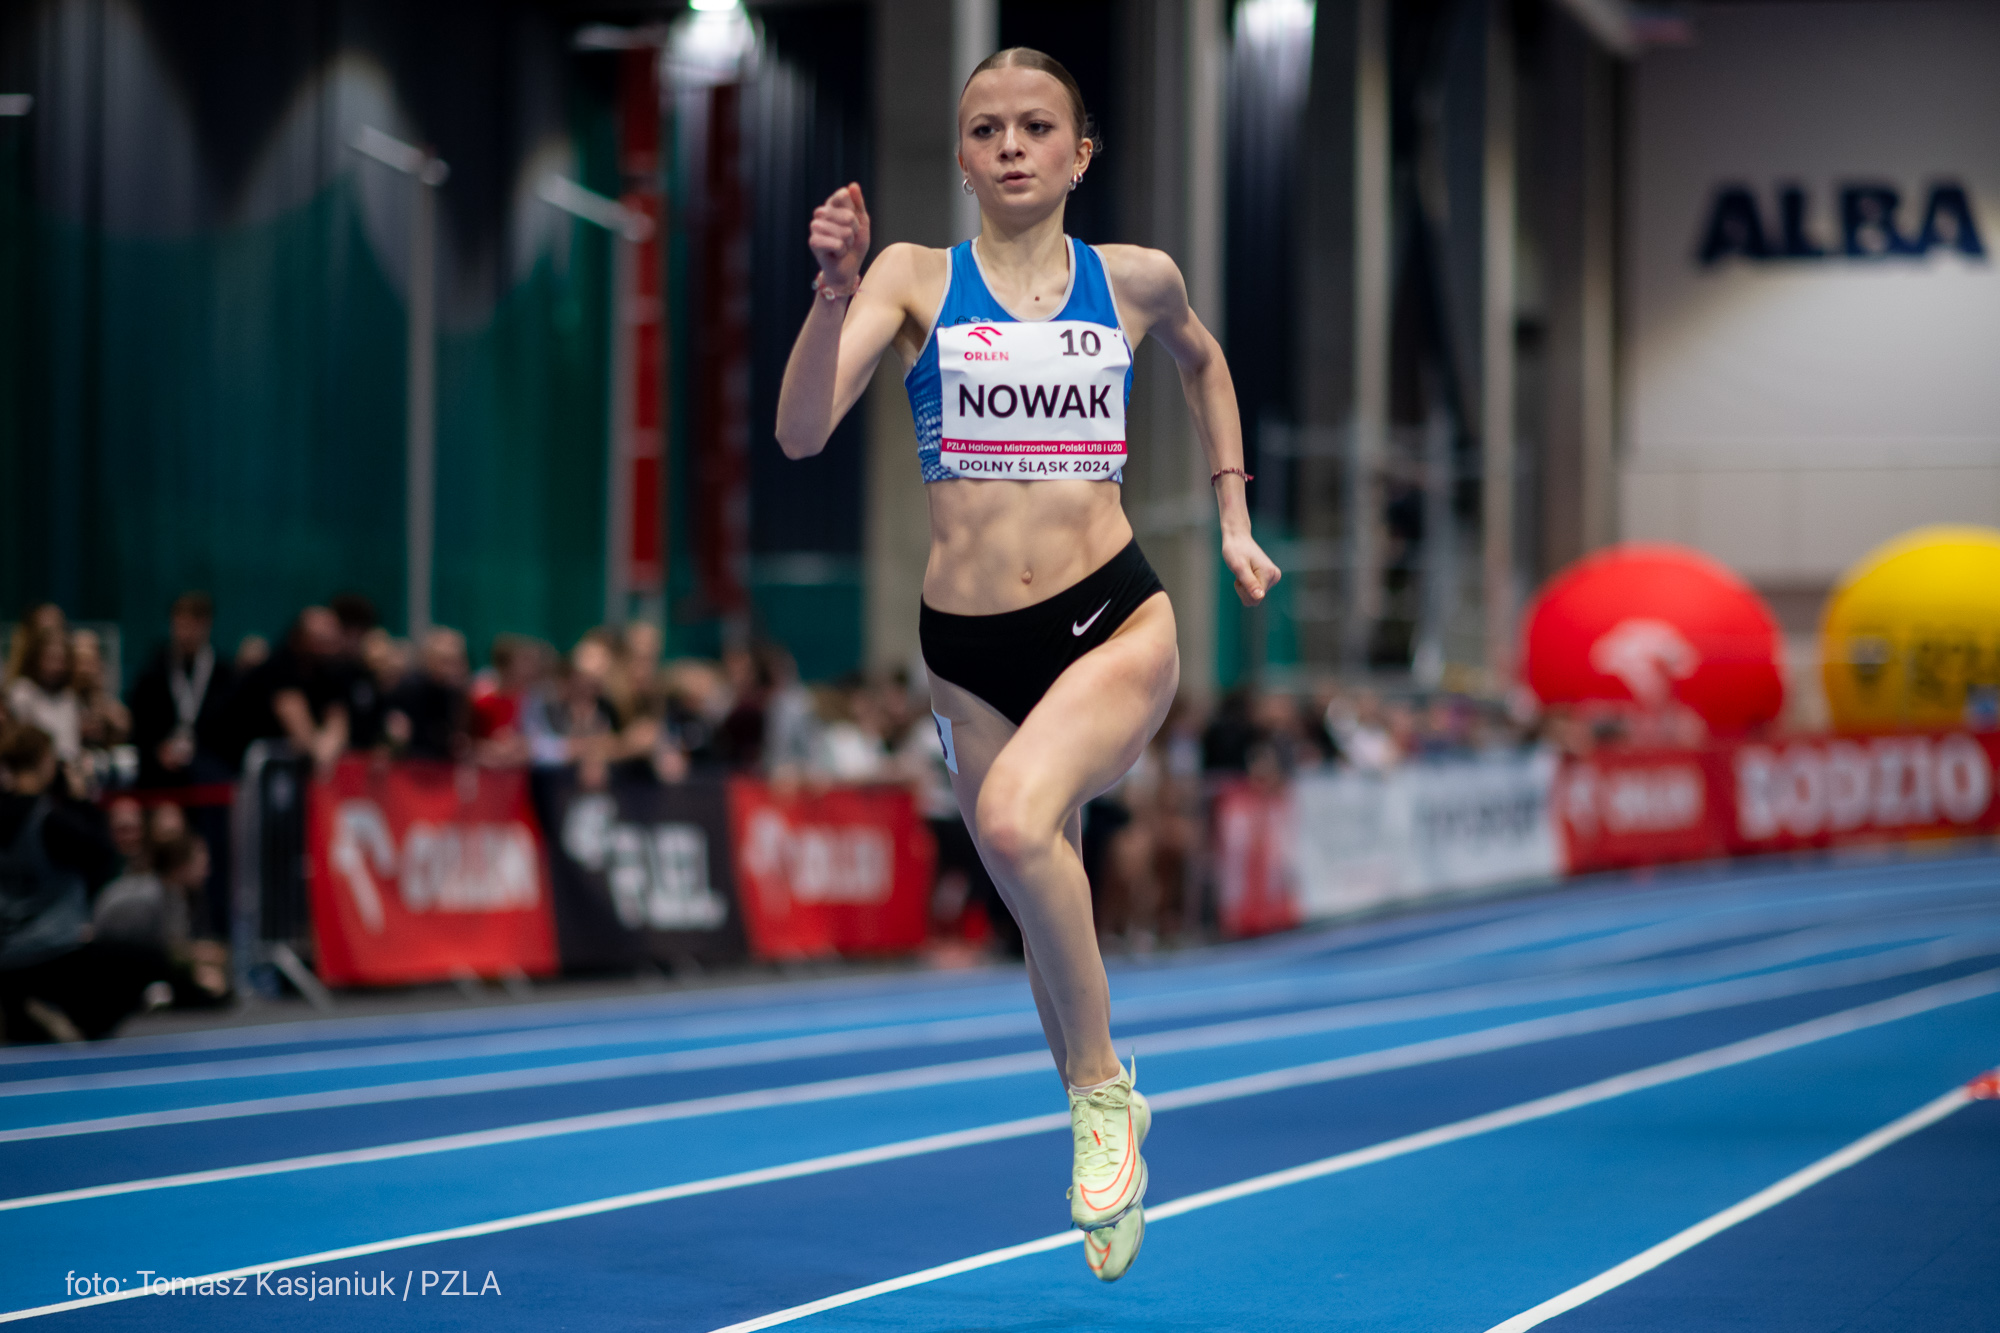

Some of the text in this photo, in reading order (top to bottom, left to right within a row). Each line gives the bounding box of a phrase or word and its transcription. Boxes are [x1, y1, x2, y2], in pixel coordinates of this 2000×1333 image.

[1697, 181, 1987, 264] ALBA
[1059, 329, 1102, 357] 10
[964, 351, 1009, 361] ORLEN
[958, 384, 1112, 419] NOWAK
[946, 441, 967, 451] PZLA
[968, 443, 1003, 452] Halowe
[1004, 443, 1058, 453] Mistrzostwa
[1060, 443, 1086, 452] Polski
[1087, 443, 1102, 452] U18
[1107, 443, 1123, 452] U20
[959, 457, 1110, 476] DOLNY ŚLĄSK 2024
